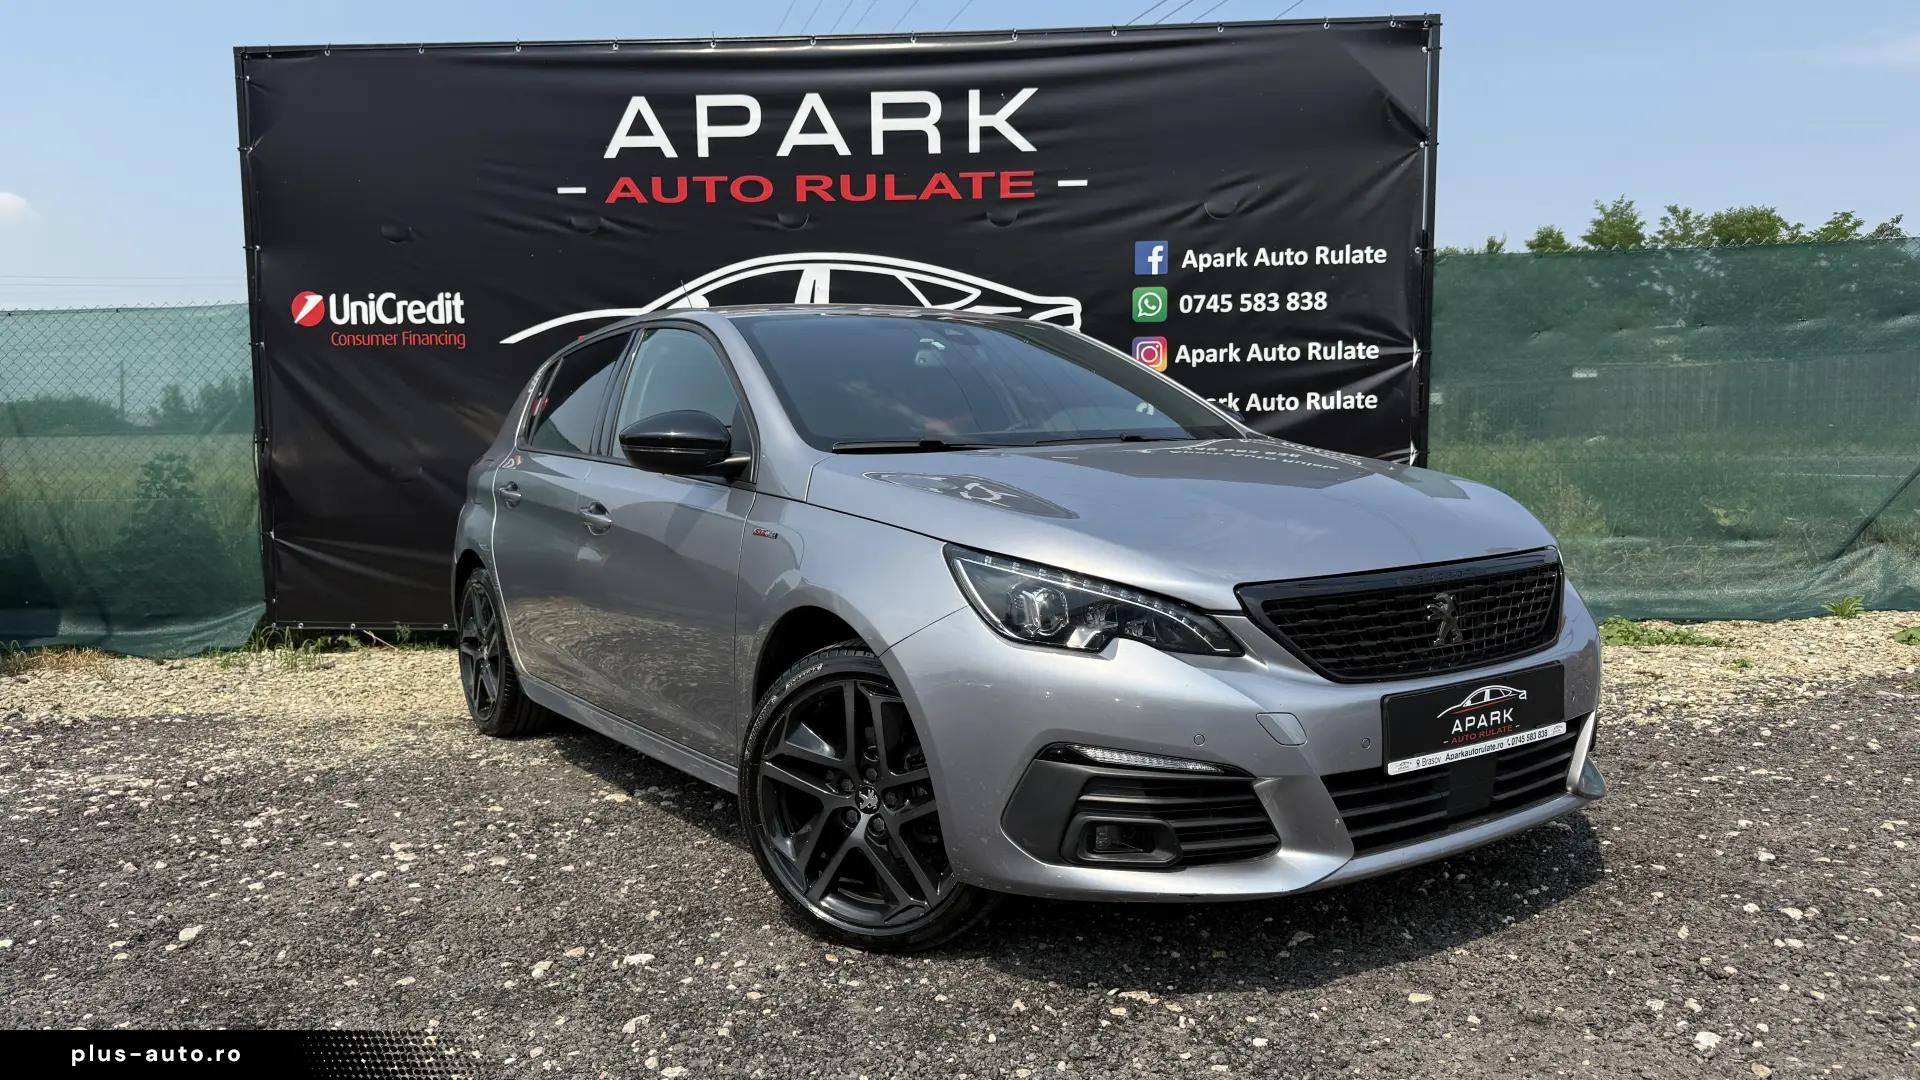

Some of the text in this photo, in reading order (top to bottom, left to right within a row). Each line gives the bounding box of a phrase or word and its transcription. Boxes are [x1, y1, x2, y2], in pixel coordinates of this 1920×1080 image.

[603, 87, 1039, 158] APARK
[605, 170, 1036, 204] AUTO RULATE
[1181, 244, 1387, 272] Apark Auto Rulate
[329, 292, 465, 325] UniCredit
[1179, 291, 1328, 314] 0745 583 838
[331, 330, 466, 349] Consumer Financing
[1175, 341, 1380, 367] Apark Auto Rulate
[1245, 393, 1299, 412] Auto
[1306, 390, 1378, 410] Rulate
[1451, 708, 1513, 734] APARK
[1445, 743, 1503, 761] Aparkautorulate.ro
[1511, 735, 1525, 746] 0745
[1526, 732, 1537, 743] 583
[1537, 729, 1548, 740] 838
[1451, 725, 1513, 744] AUTO RULATE
